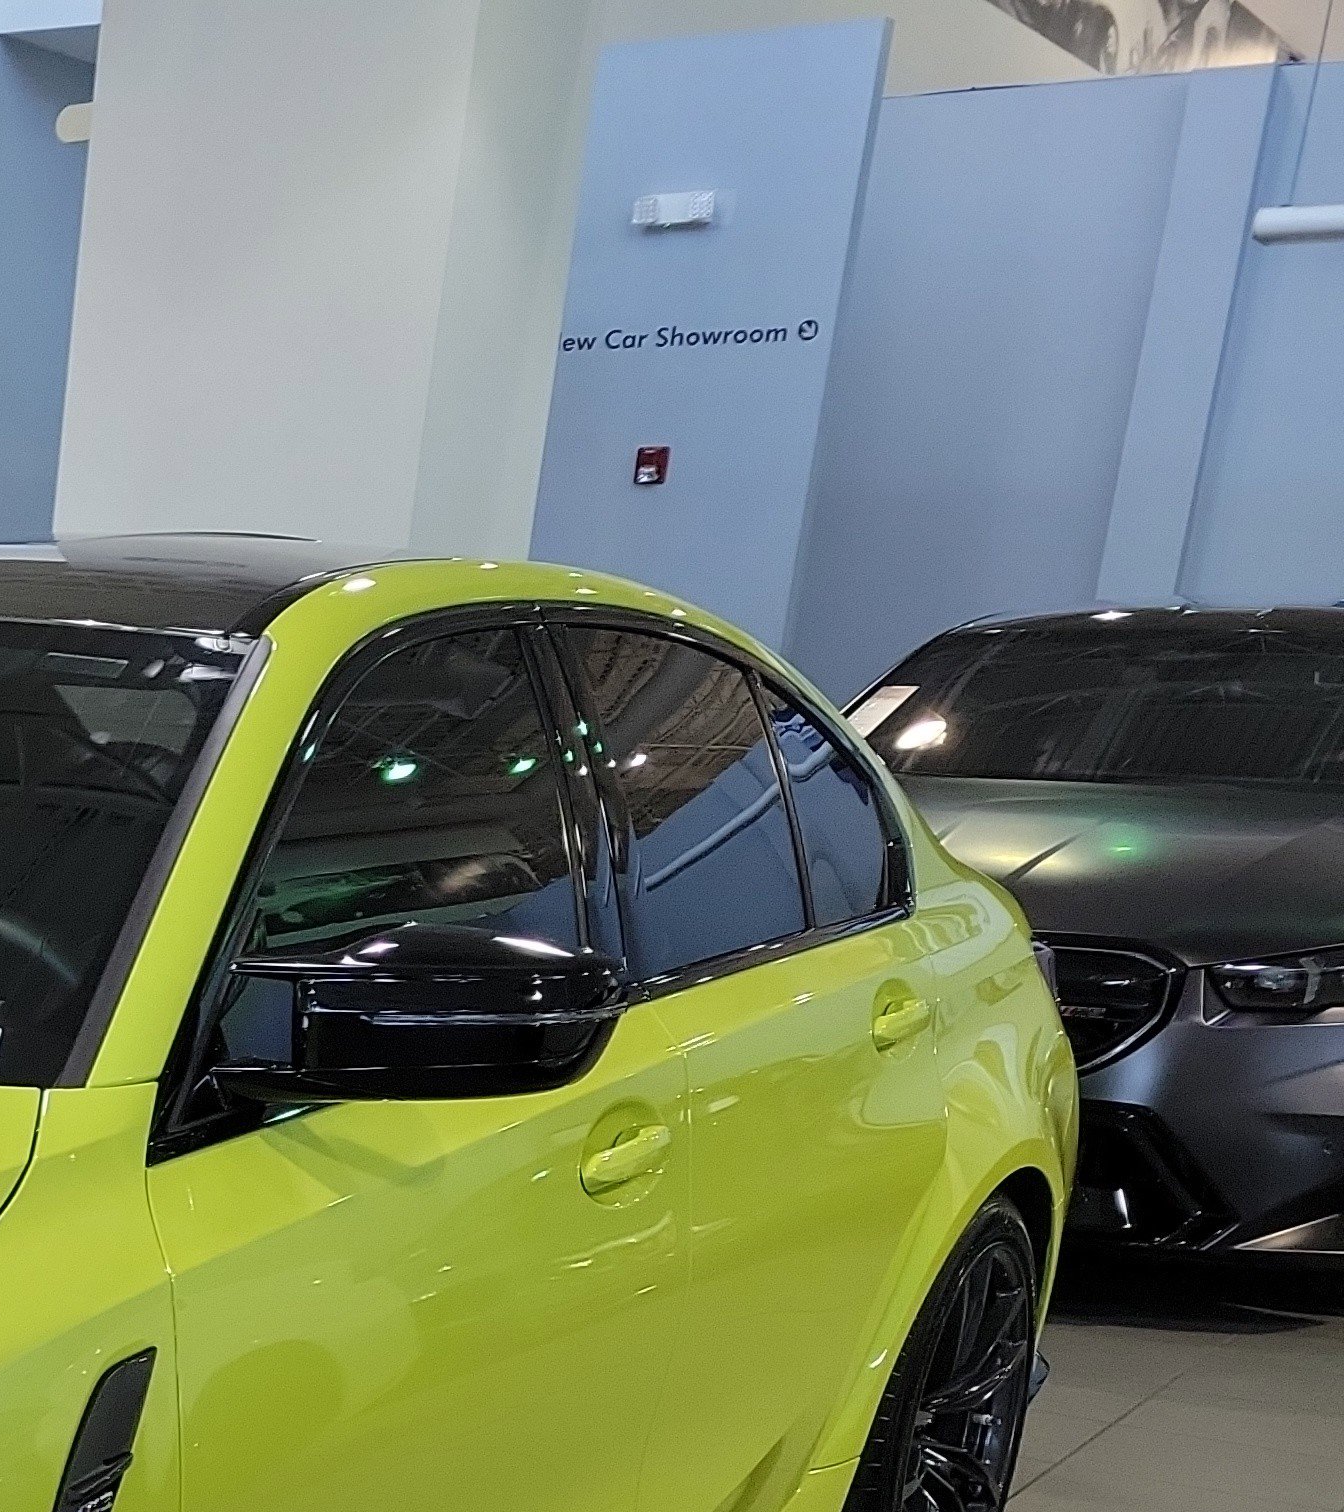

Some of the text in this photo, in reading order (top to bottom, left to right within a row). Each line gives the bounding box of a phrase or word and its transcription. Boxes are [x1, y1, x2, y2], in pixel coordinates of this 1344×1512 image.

[559, 326, 788, 351] ew Car Showroom
